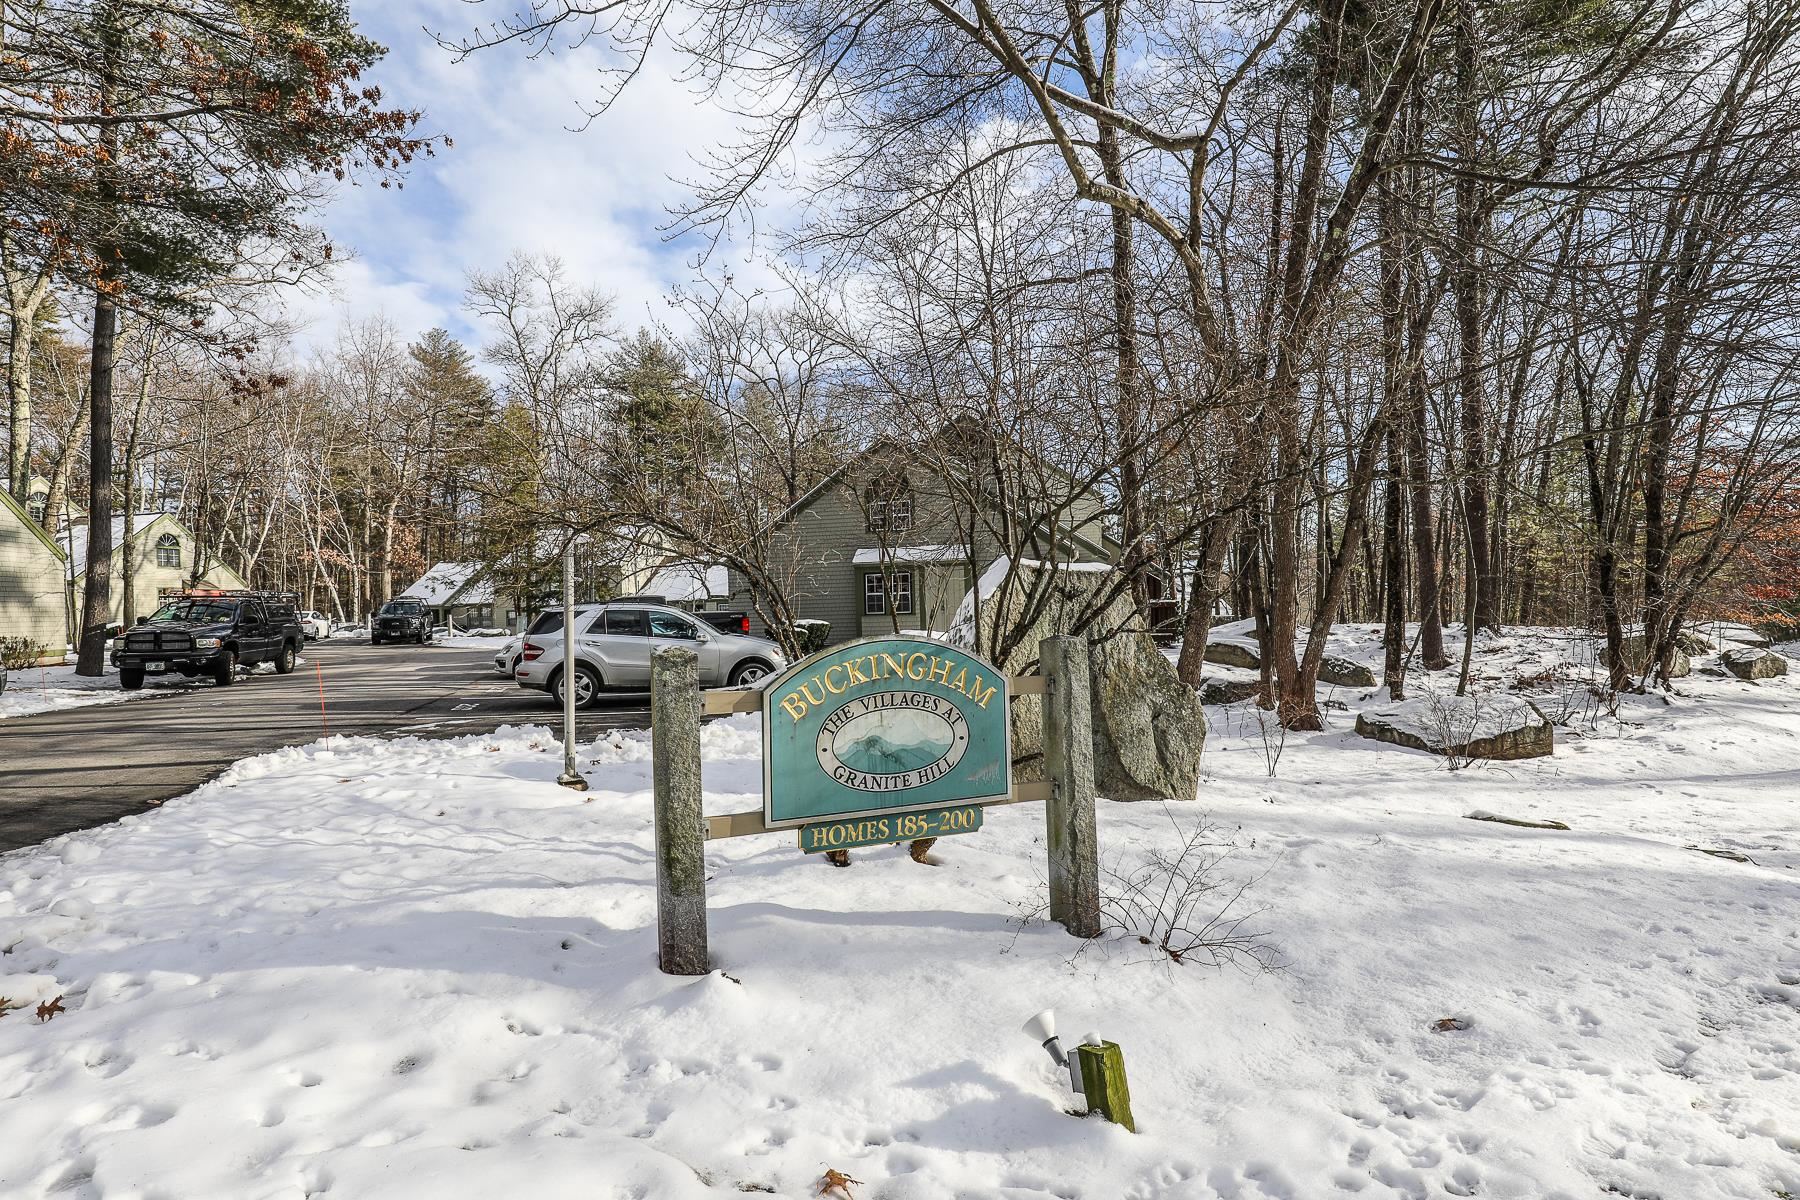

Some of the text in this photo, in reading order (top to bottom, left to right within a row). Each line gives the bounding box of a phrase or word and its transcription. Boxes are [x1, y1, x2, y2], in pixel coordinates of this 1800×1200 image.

[779, 652, 998, 723] BUCKINGHAM
[822, 692, 964, 736] THE VILLAGES AT
[833, 757, 955, 790] GRANITE HILL
[811, 819, 890, 848] HOMES
